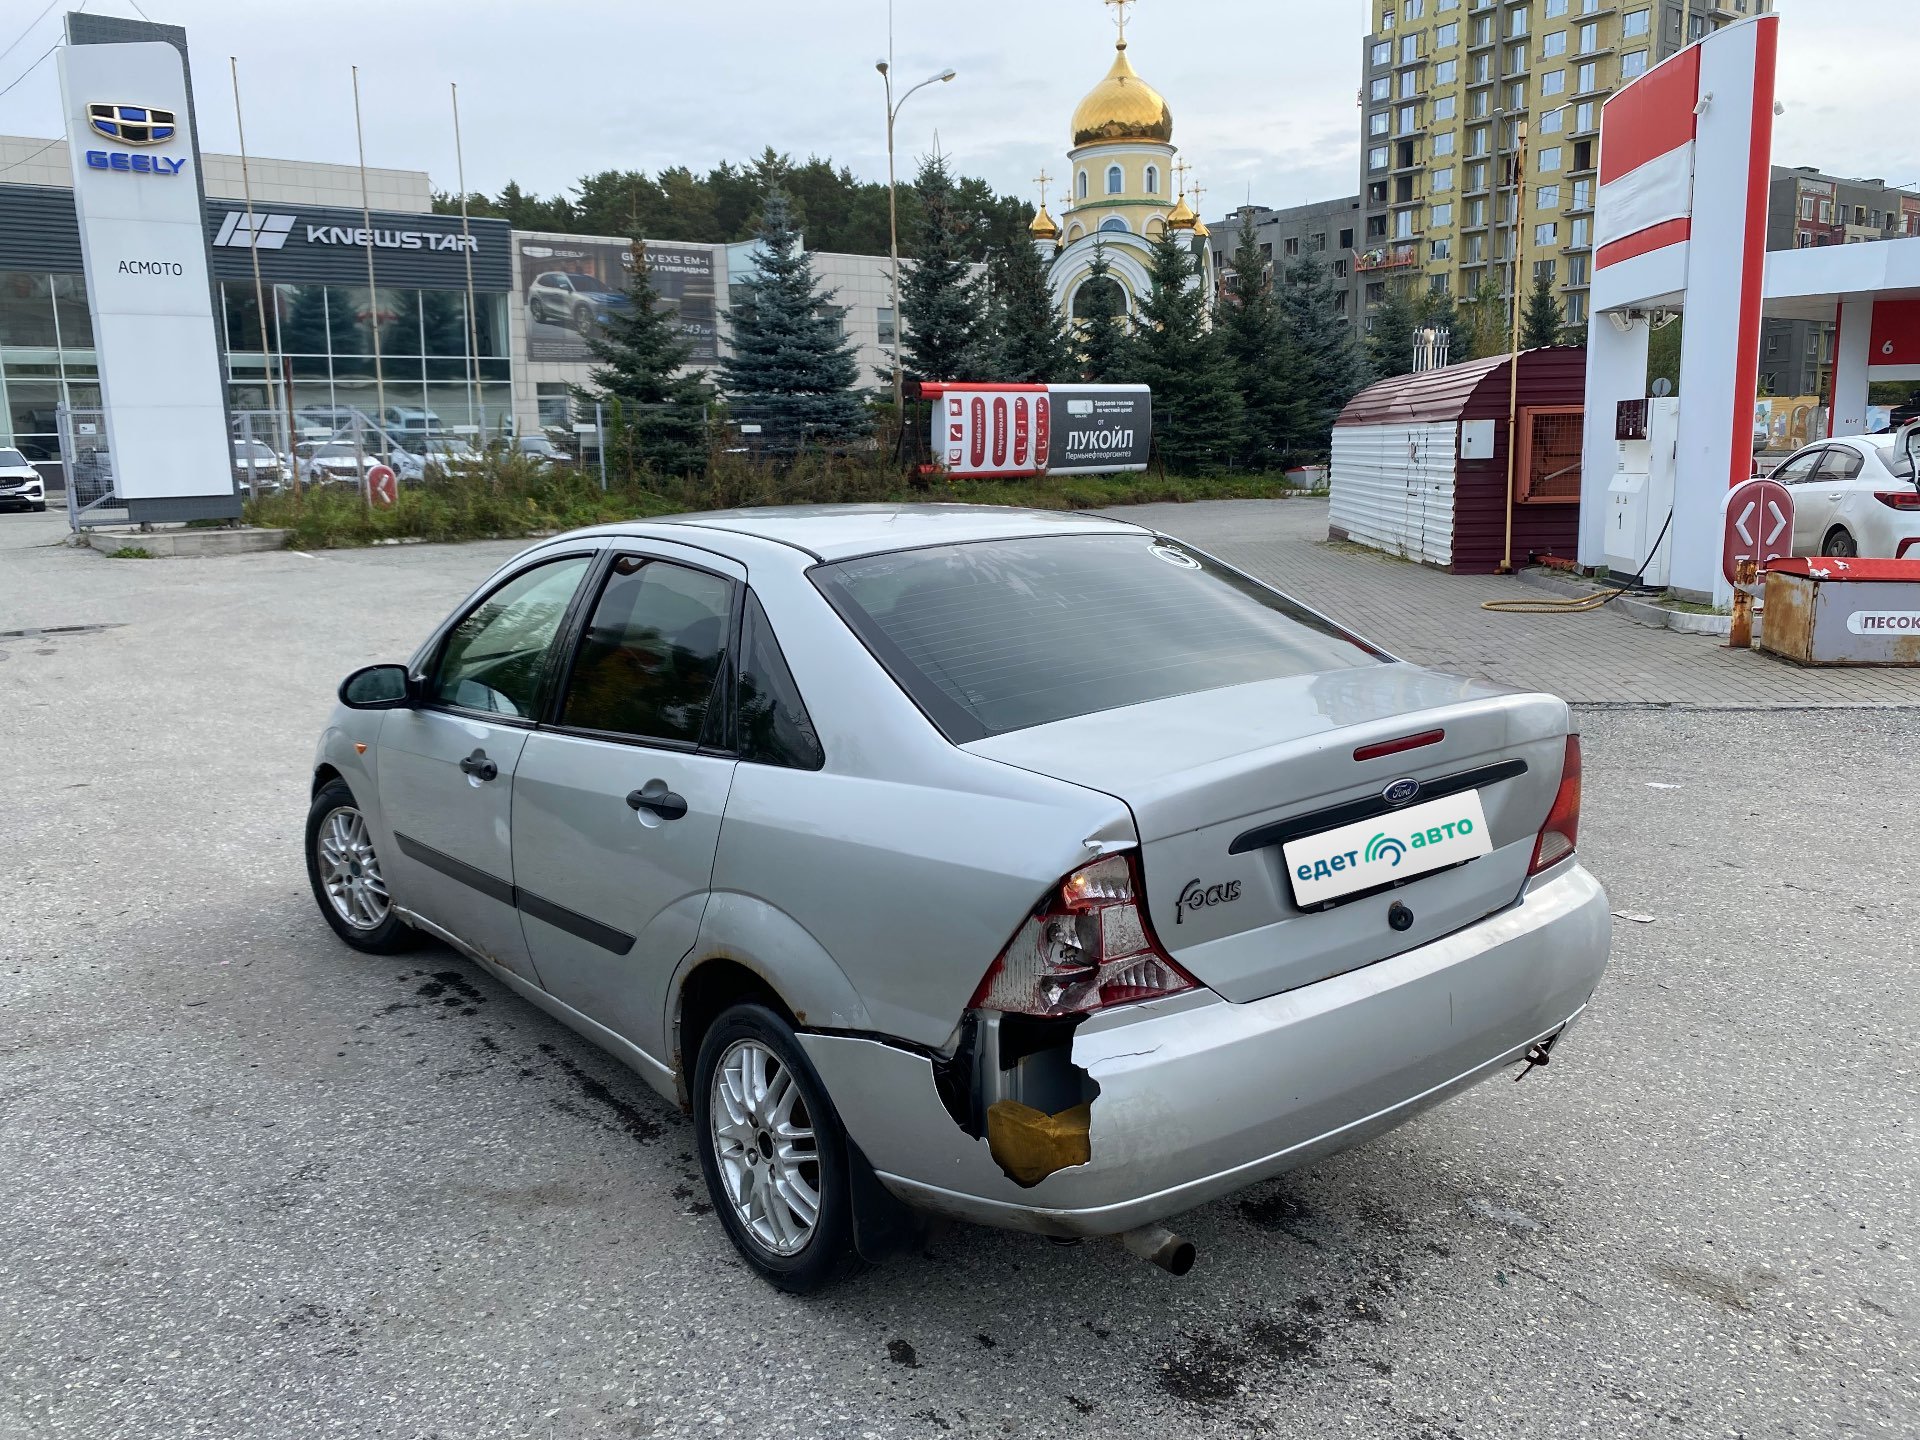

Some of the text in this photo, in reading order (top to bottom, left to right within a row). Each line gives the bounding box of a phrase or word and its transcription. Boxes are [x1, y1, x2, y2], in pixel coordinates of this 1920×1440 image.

[86, 150, 187, 175] GEELY
[306, 225, 479, 252] KNEWSTAR
[554, 250, 584, 258] GEELY
[621, 252, 656, 262] GLY
[118, 260, 183, 276] АСМОТО
[1882, 340, 1894, 355] 6
[1066, 425, 1134, 450] ЛУКОЙЛ
[1065, 451, 1131, 460] Пермьнефтеоргсинтез
[1863, 616, 1920, 629] ПЕСОК
[1392, 783, 1412, 799] Ford
